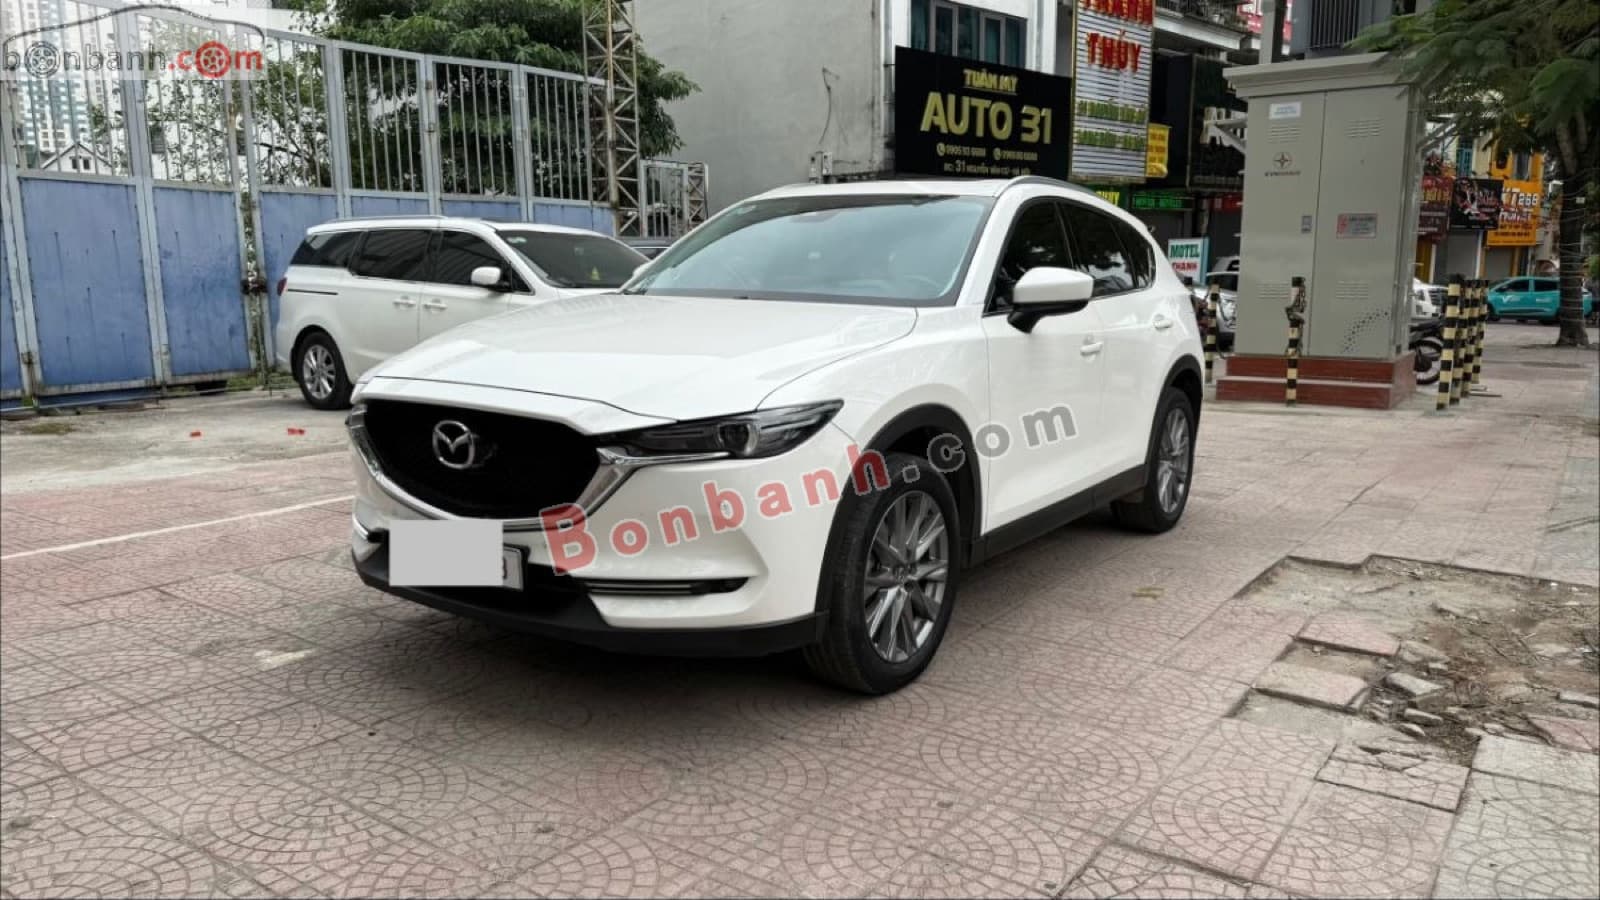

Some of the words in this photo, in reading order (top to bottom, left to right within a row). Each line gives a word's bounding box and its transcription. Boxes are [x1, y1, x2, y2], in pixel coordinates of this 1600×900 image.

[1086, 29, 1141, 74] THÚY
[920, 91, 1013, 140] AUTO
[1020, 104, 1052, 145] 31
[955, 160, 966, 173] 31
[1170, 244, 1200, 258] MOTEL
